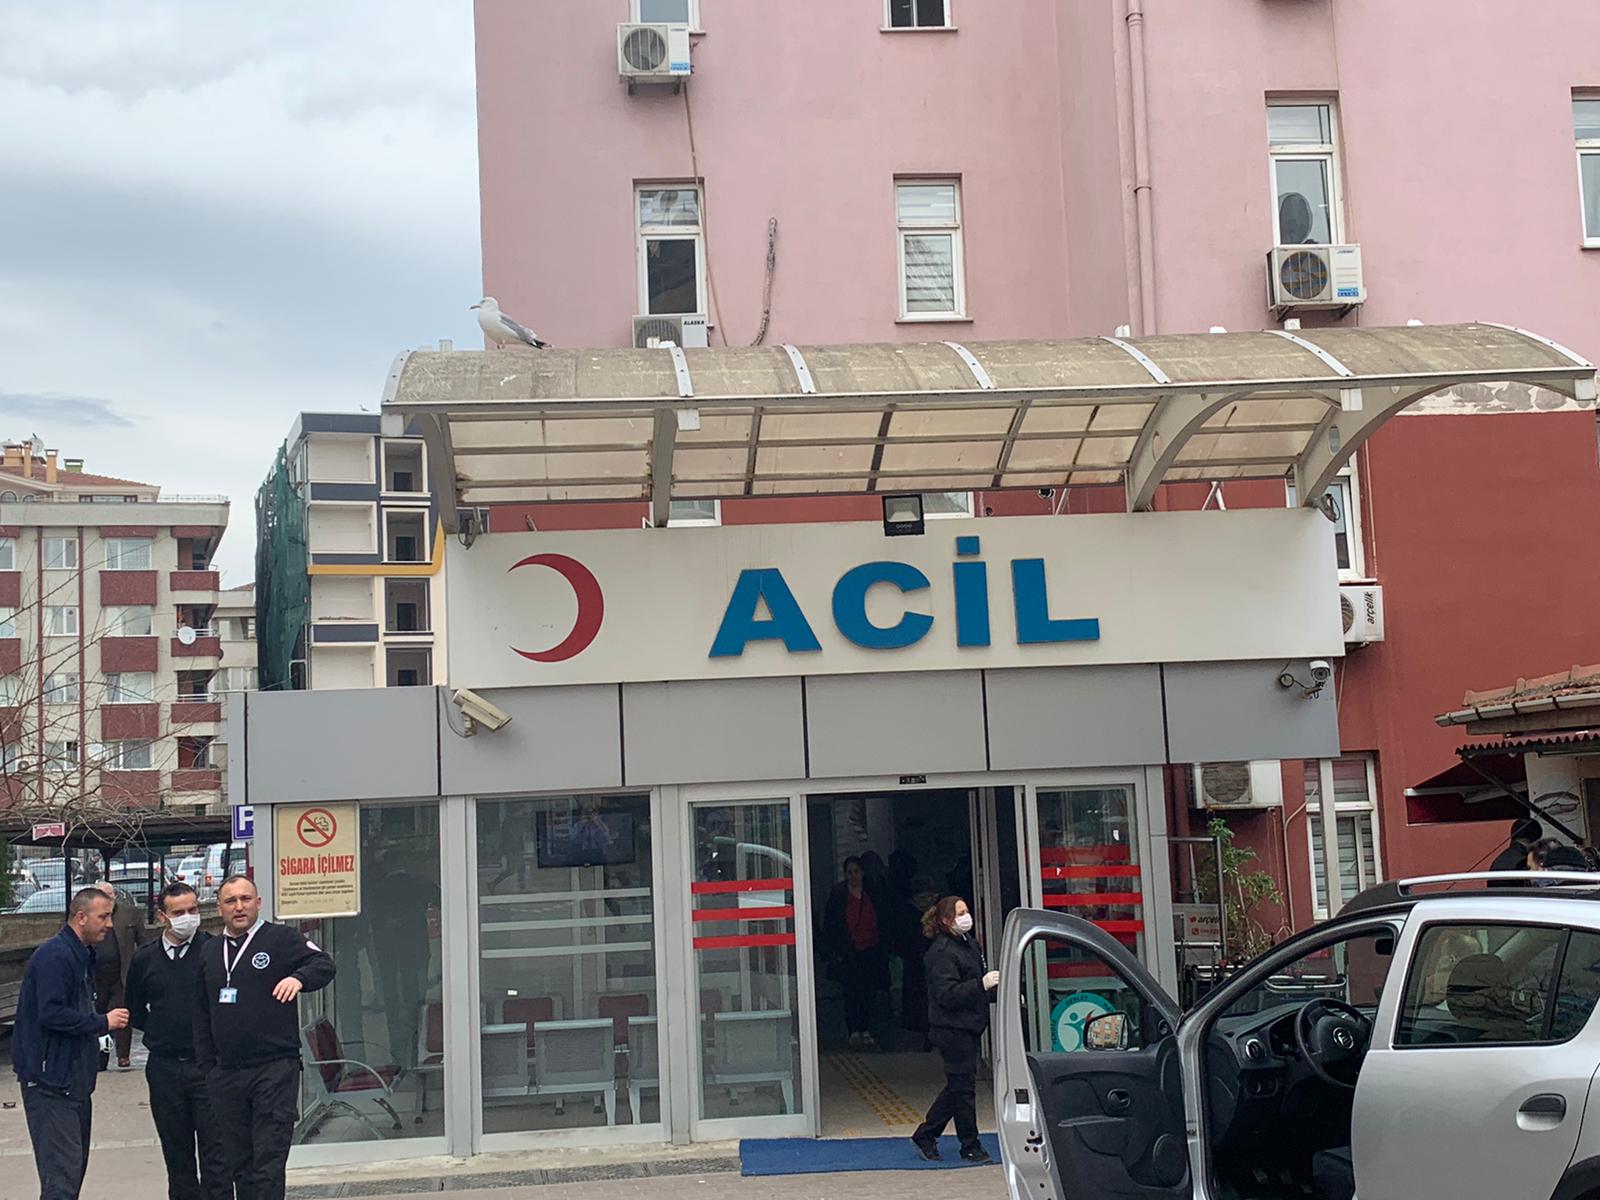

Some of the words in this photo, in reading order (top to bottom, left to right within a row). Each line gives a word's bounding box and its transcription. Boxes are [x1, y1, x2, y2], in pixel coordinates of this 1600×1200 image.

[709, 535, 1101, 658] ACİL
[1364, 591, 1377, 625] arçelik
[238, 805, 254, 831] P
[280, 856, 315, 876] SİGARA
[318, 853, 355, 877] İÇİLMEZ
